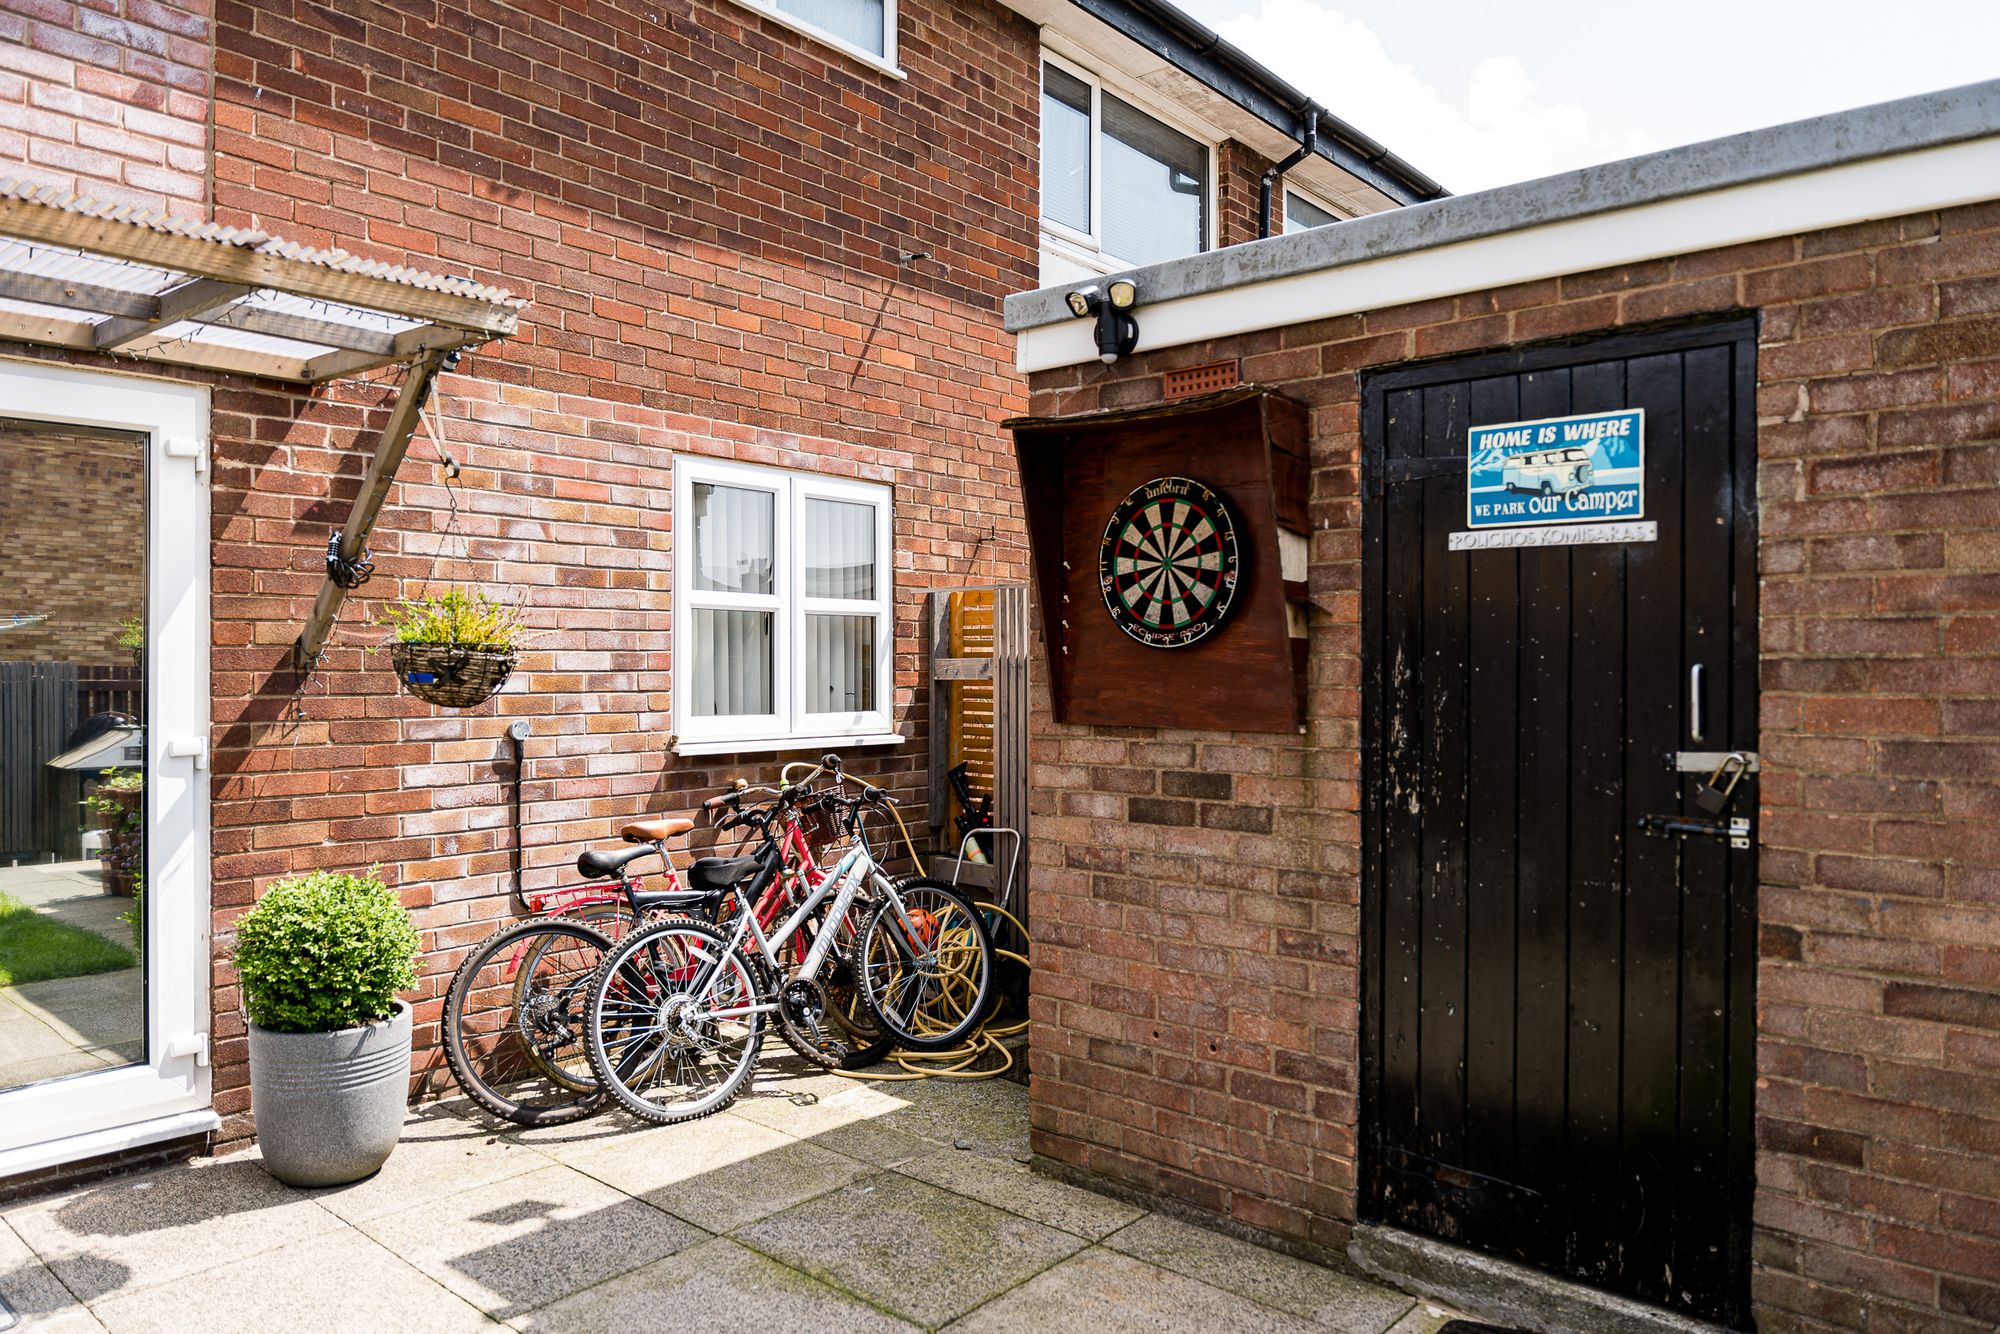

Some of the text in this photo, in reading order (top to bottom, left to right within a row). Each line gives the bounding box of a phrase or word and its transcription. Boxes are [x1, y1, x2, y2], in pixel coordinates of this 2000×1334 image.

[1479, 418, 1632, 450] HOME IS WHERE
[1475, 504, 1491, 517] WE
[1493, 501, 1526, 516] PARK
[1564, 488, 1638, 515] Camper
